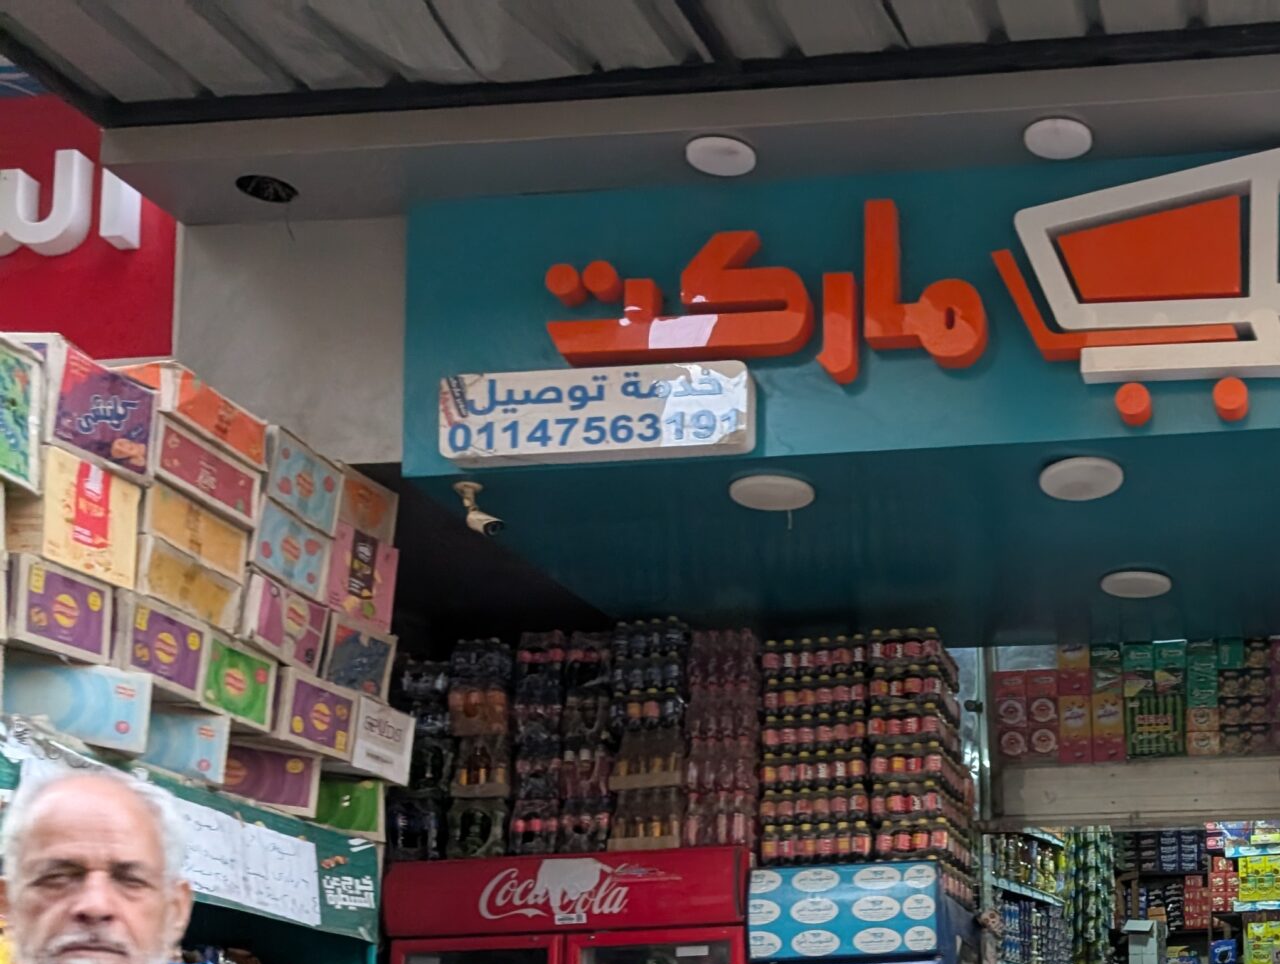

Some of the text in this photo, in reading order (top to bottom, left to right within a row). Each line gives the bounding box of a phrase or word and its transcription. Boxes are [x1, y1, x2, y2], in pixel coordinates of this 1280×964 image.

[544, 198, 988, 386] ماركت
[466, 368, 723, 417] خدمة توصيل
